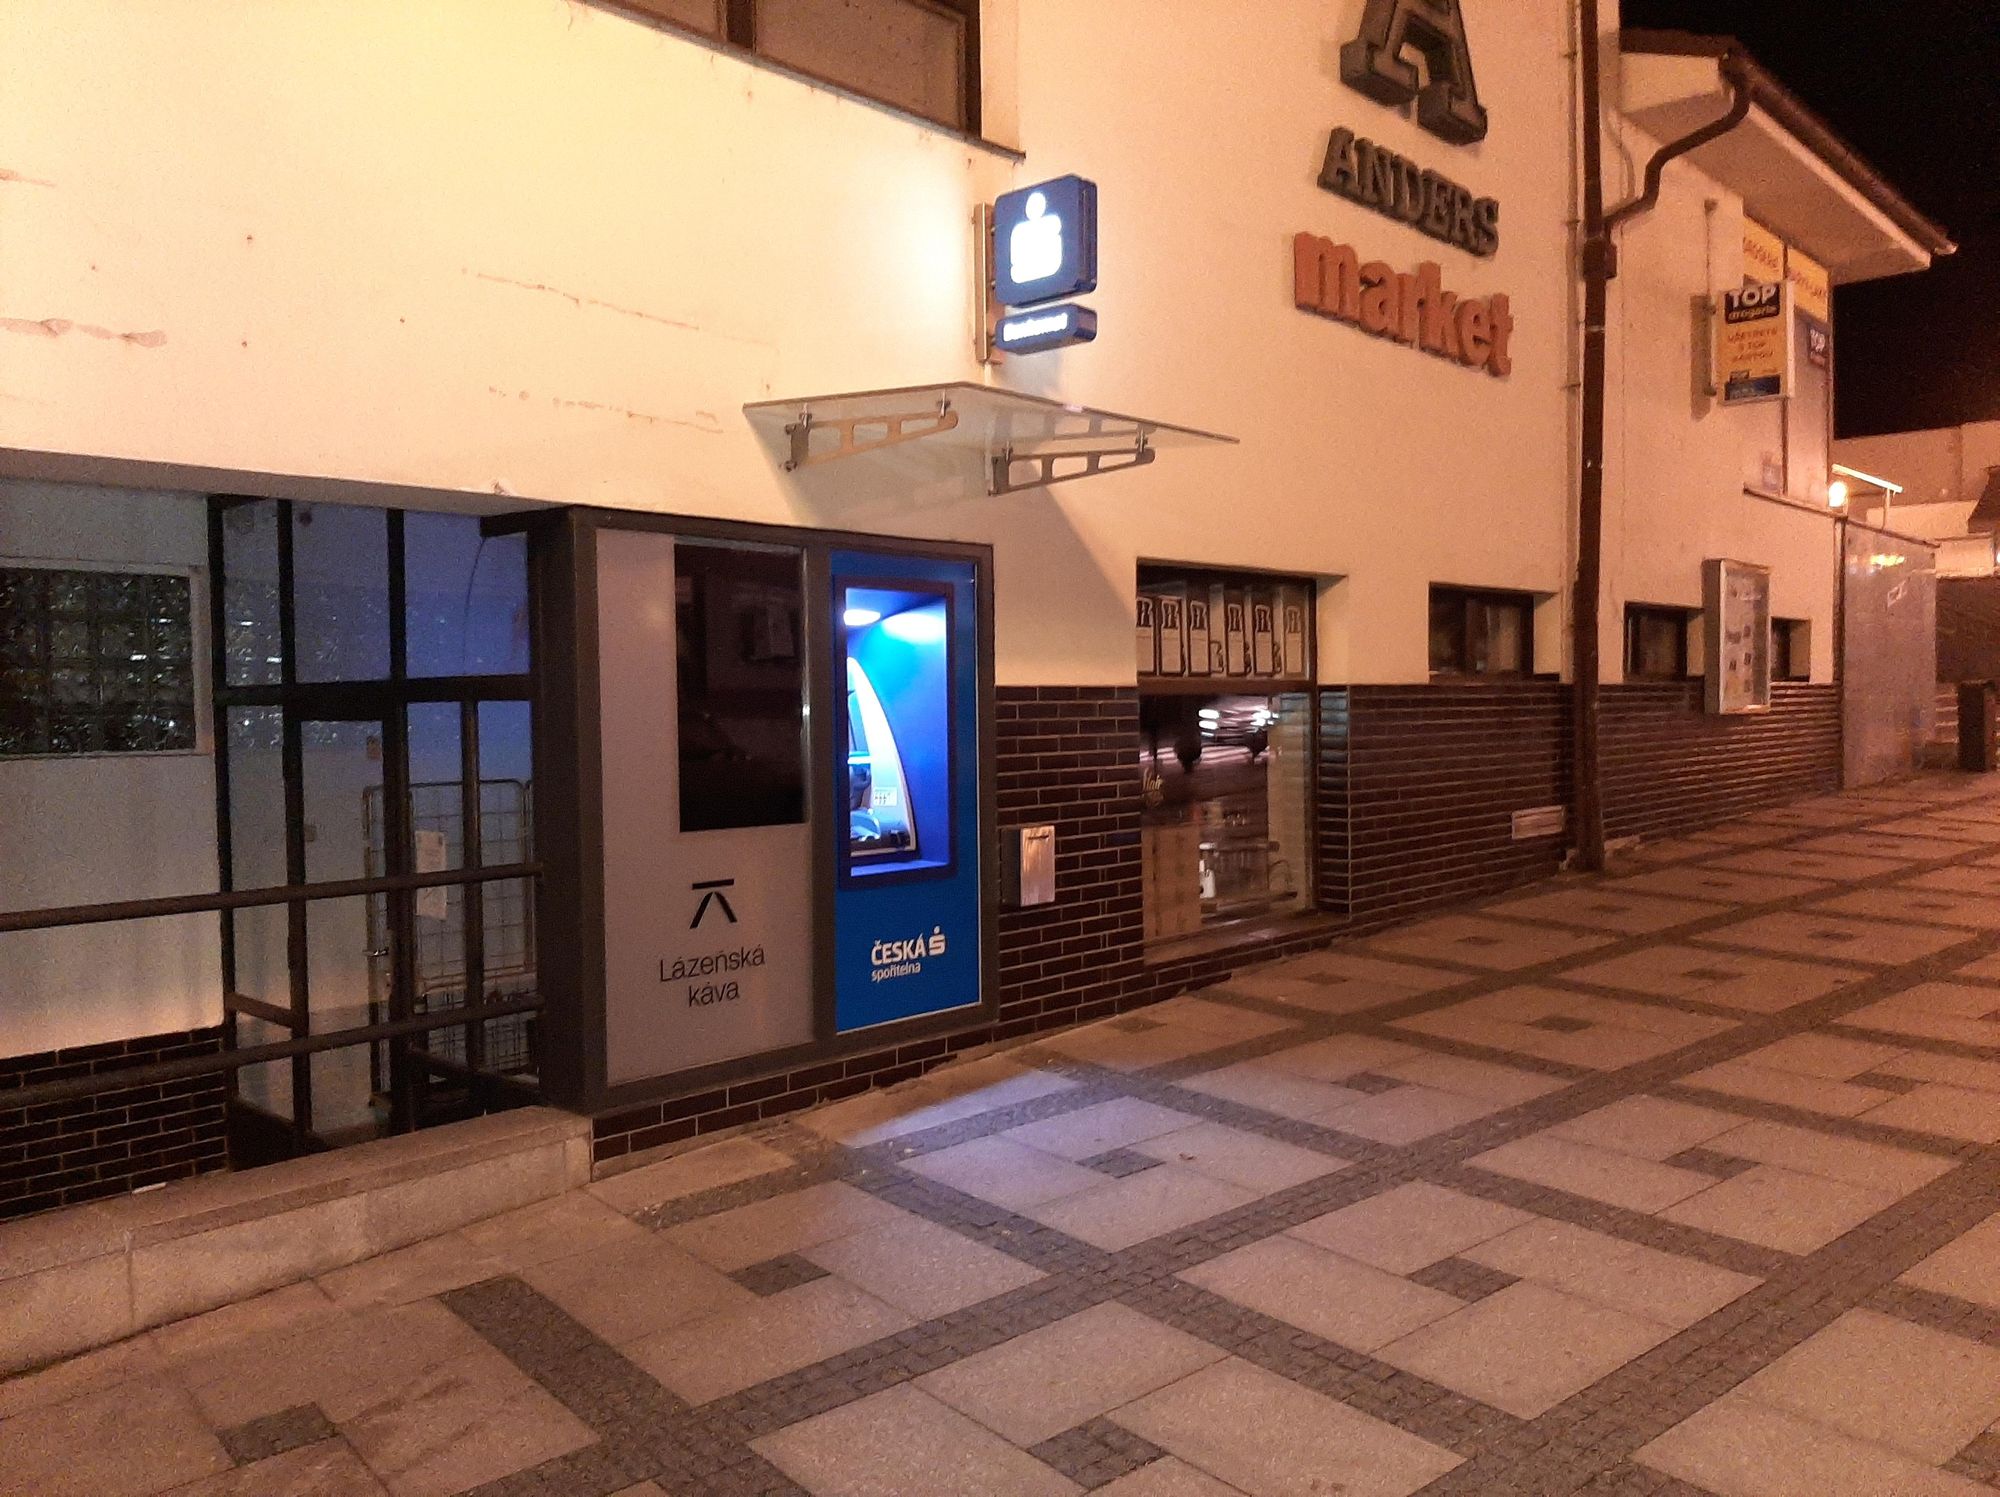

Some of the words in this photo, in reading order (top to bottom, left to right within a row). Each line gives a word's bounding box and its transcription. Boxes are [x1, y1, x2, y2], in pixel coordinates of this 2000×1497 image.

[1317, 126, 1500, 257] ANDERS
[1293, 231, 1514, 377] market
[1729, 285, 1777, 308] TOP
[660, 944, 765, 982] Lázeňská
[871, 933, 927, 966] ČESKÁ
[871, 961, 921, 983] spořitelna
[688, 981, 740, 1008] káva
